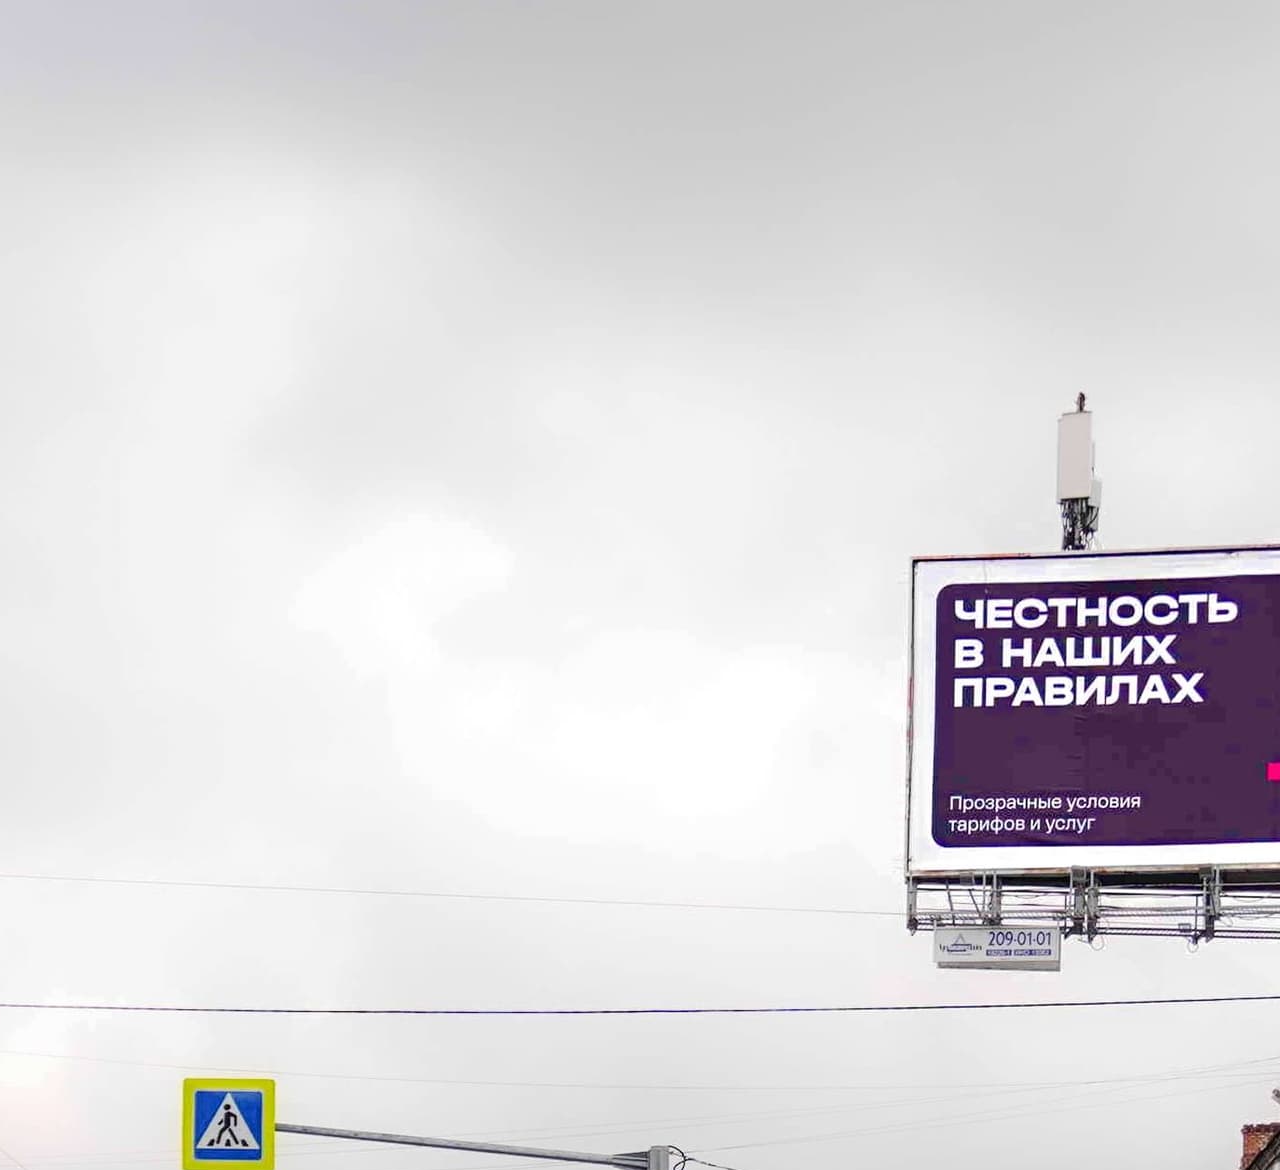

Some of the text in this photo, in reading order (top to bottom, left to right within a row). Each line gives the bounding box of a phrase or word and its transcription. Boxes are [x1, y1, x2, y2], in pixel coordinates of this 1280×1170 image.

[954, 592, 1239, 629] ЧЕСТНОСТЬ
[954, 634, 1178, 669] В НАШИХ
[953, 672, 1205, 708] ПРАВИЛАХ
[949, 794, 1142, 812] Прозрачные условия
[948, 817, 1096, 834] тарифов и услуг
